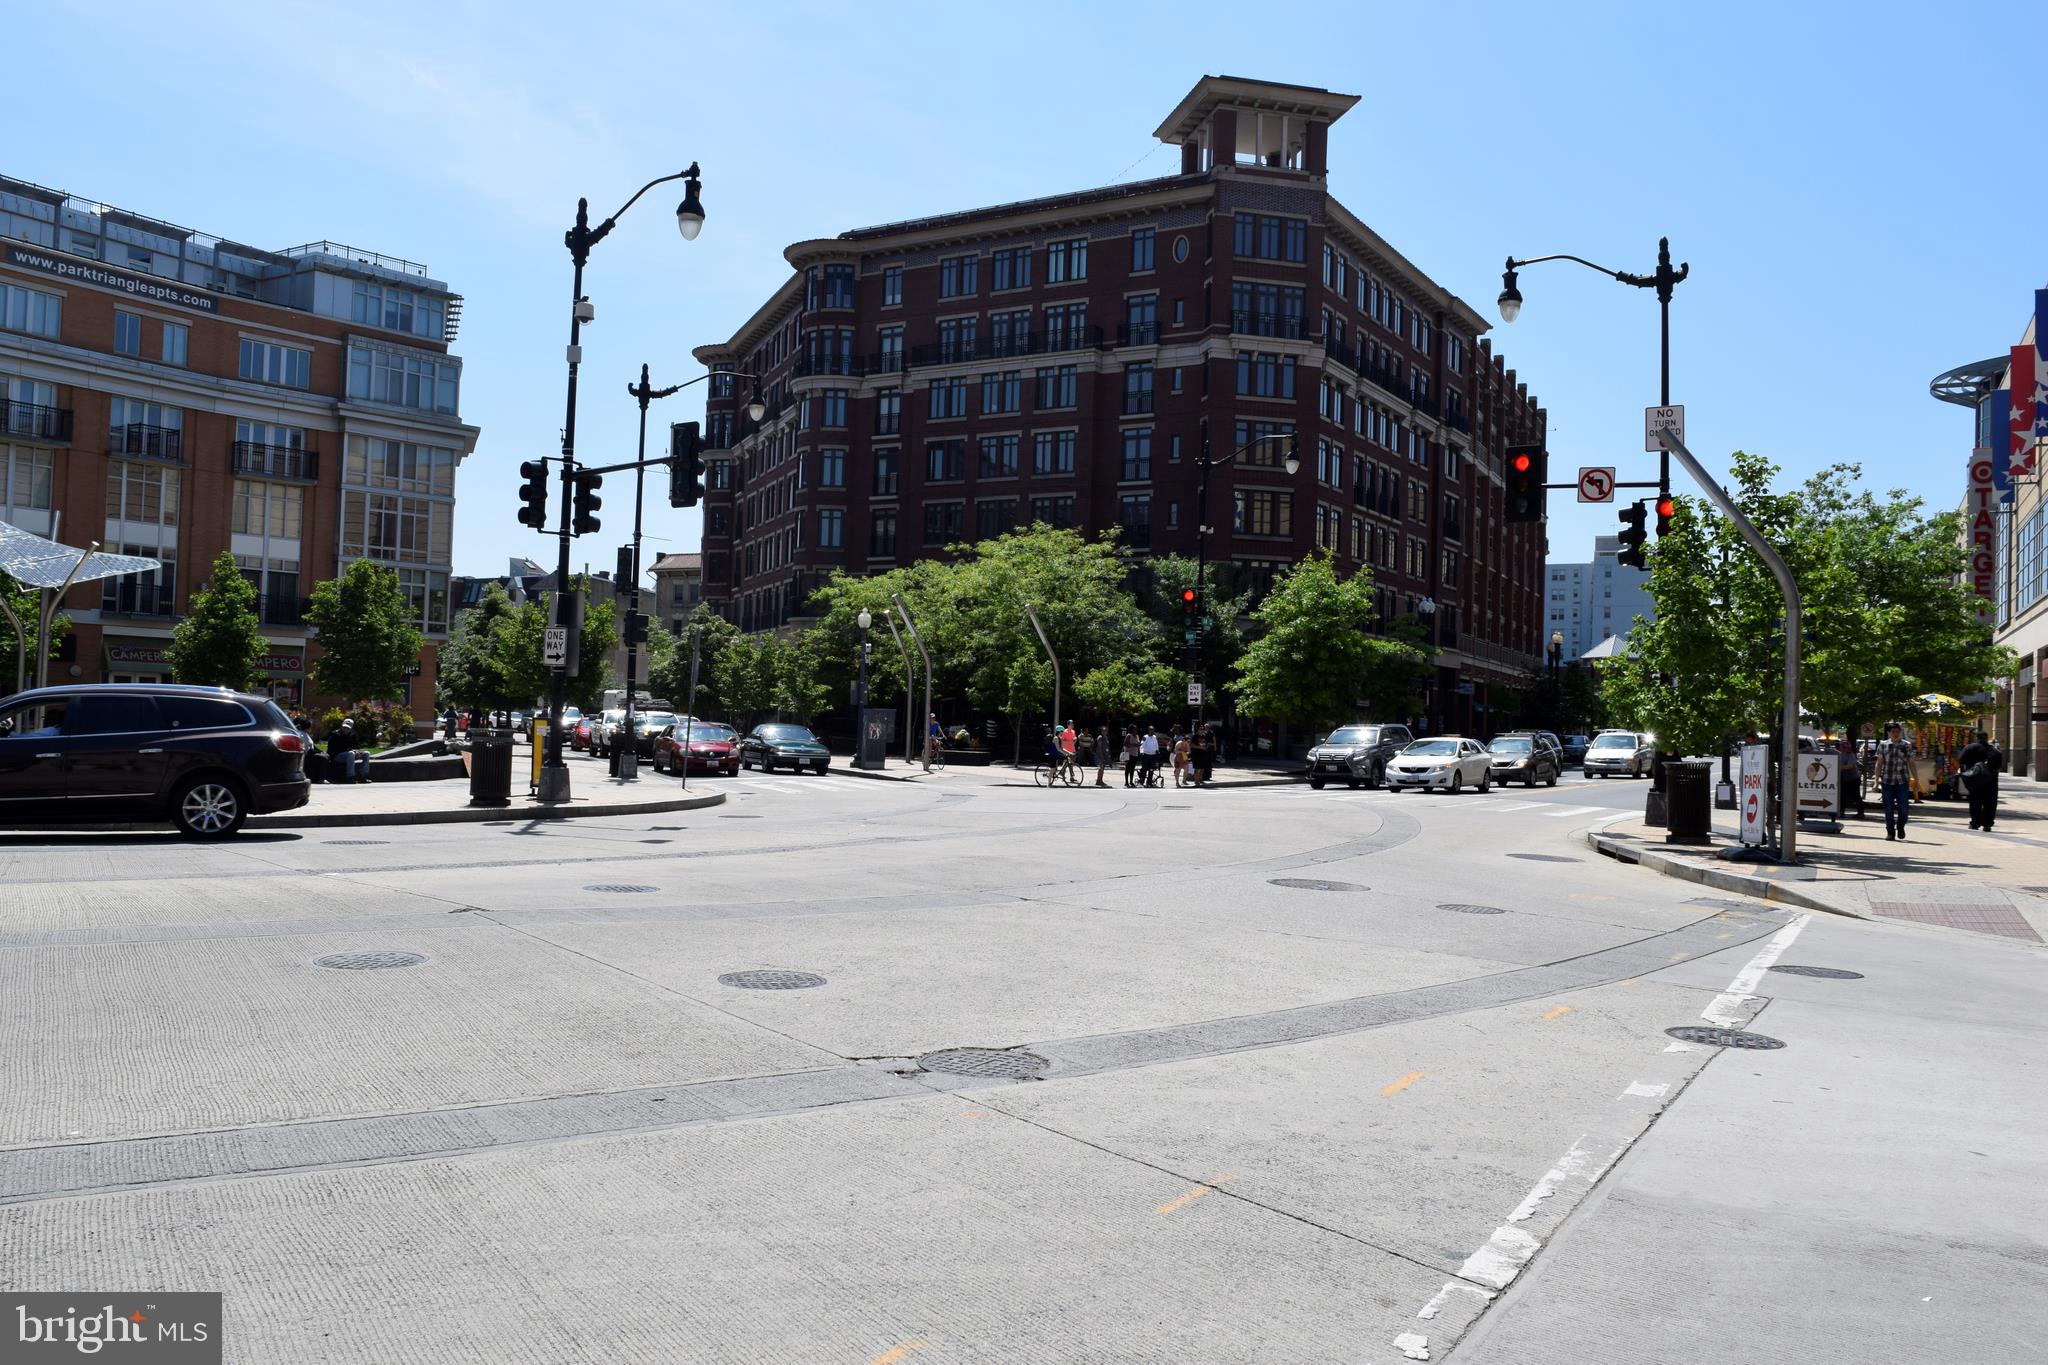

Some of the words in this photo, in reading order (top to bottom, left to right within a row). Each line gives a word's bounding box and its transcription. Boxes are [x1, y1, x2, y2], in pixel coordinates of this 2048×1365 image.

[15, 251, 212, 309] www.parktriangleapts.com
[1657, 409, 1674, 418] NO
[1654, 419, 1676, 427] TURN
[547, 631, 564, 640] ONE
[546, 641, 564, 650] WAY
[111, 649, 168, 662] CAMPER
[253, 657, 300, 669] MPERO
[1744, 775, 1762, 789] PARK
[1798, 782, 1836, 790] LETENA
